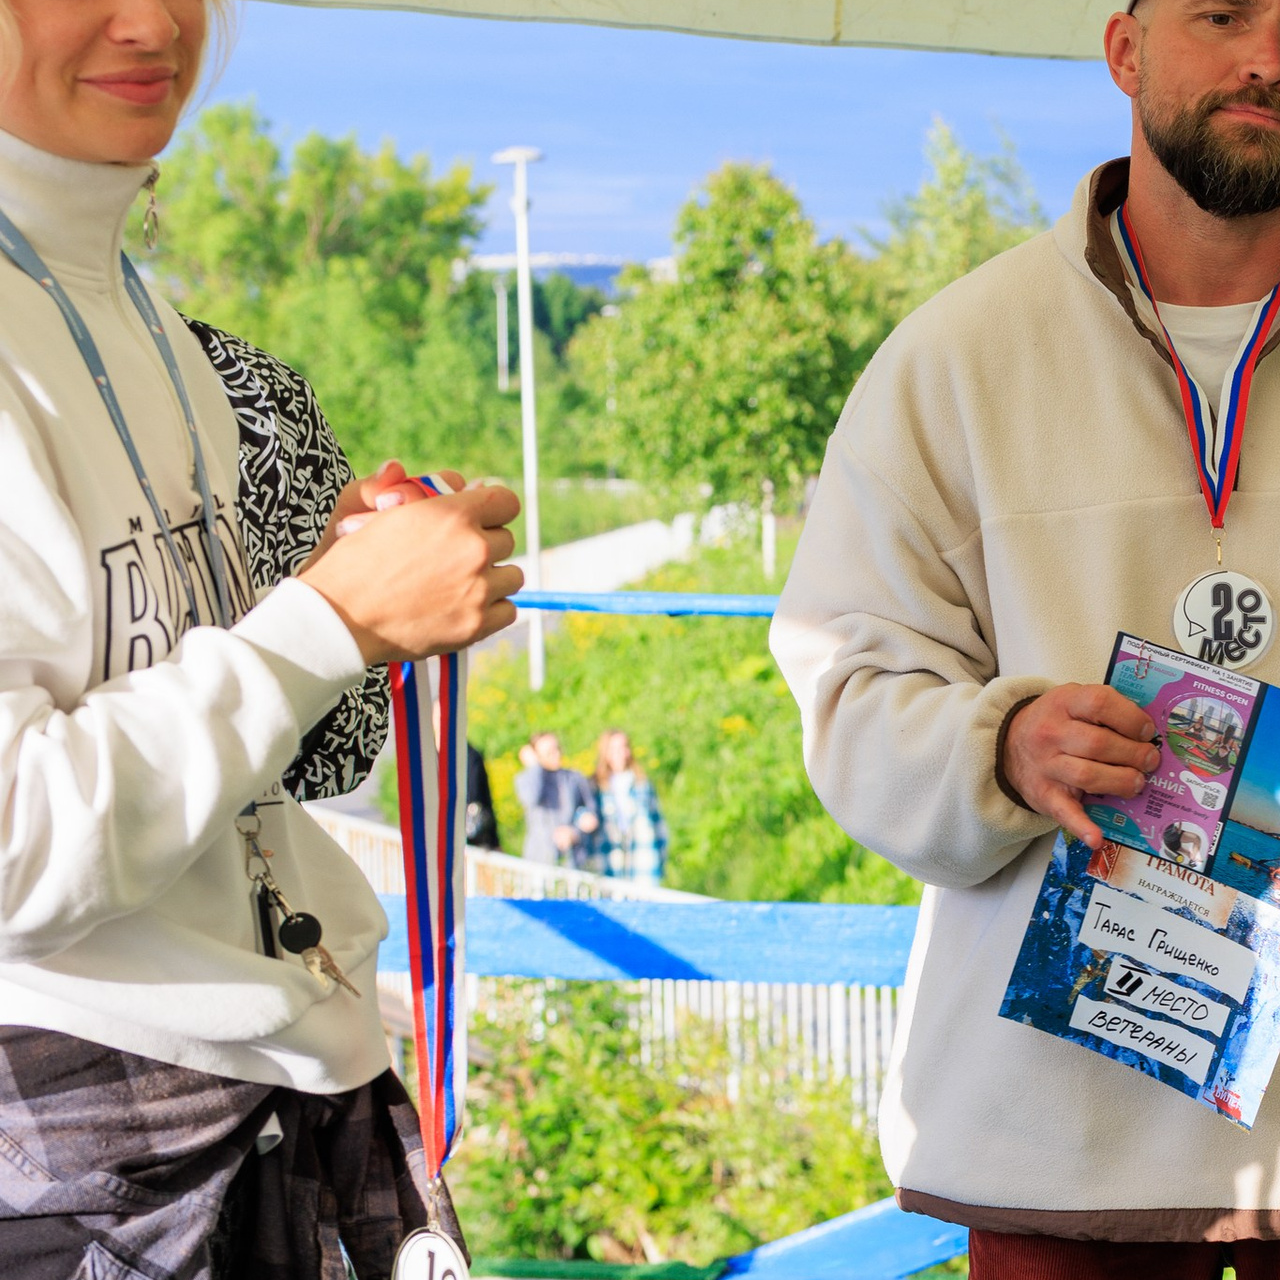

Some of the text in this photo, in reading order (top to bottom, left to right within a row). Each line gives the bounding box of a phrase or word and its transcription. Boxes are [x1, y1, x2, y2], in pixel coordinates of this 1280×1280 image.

[1212, 582, 1234, 642] 2
[1170, 654, 1210, 673] СЕРТИФИКАТ
[1226, 673, 1254, 688] ЗАНЯТИЕ
[1192, 680, 1226, 698] FITNESS
[1226, 691, 1249, 706] OPEN
[1146, 854, 1215, 896] ГРАМОТА
[1138, 878, 1210, 917] НАГРАЖДАЕТСЯ
